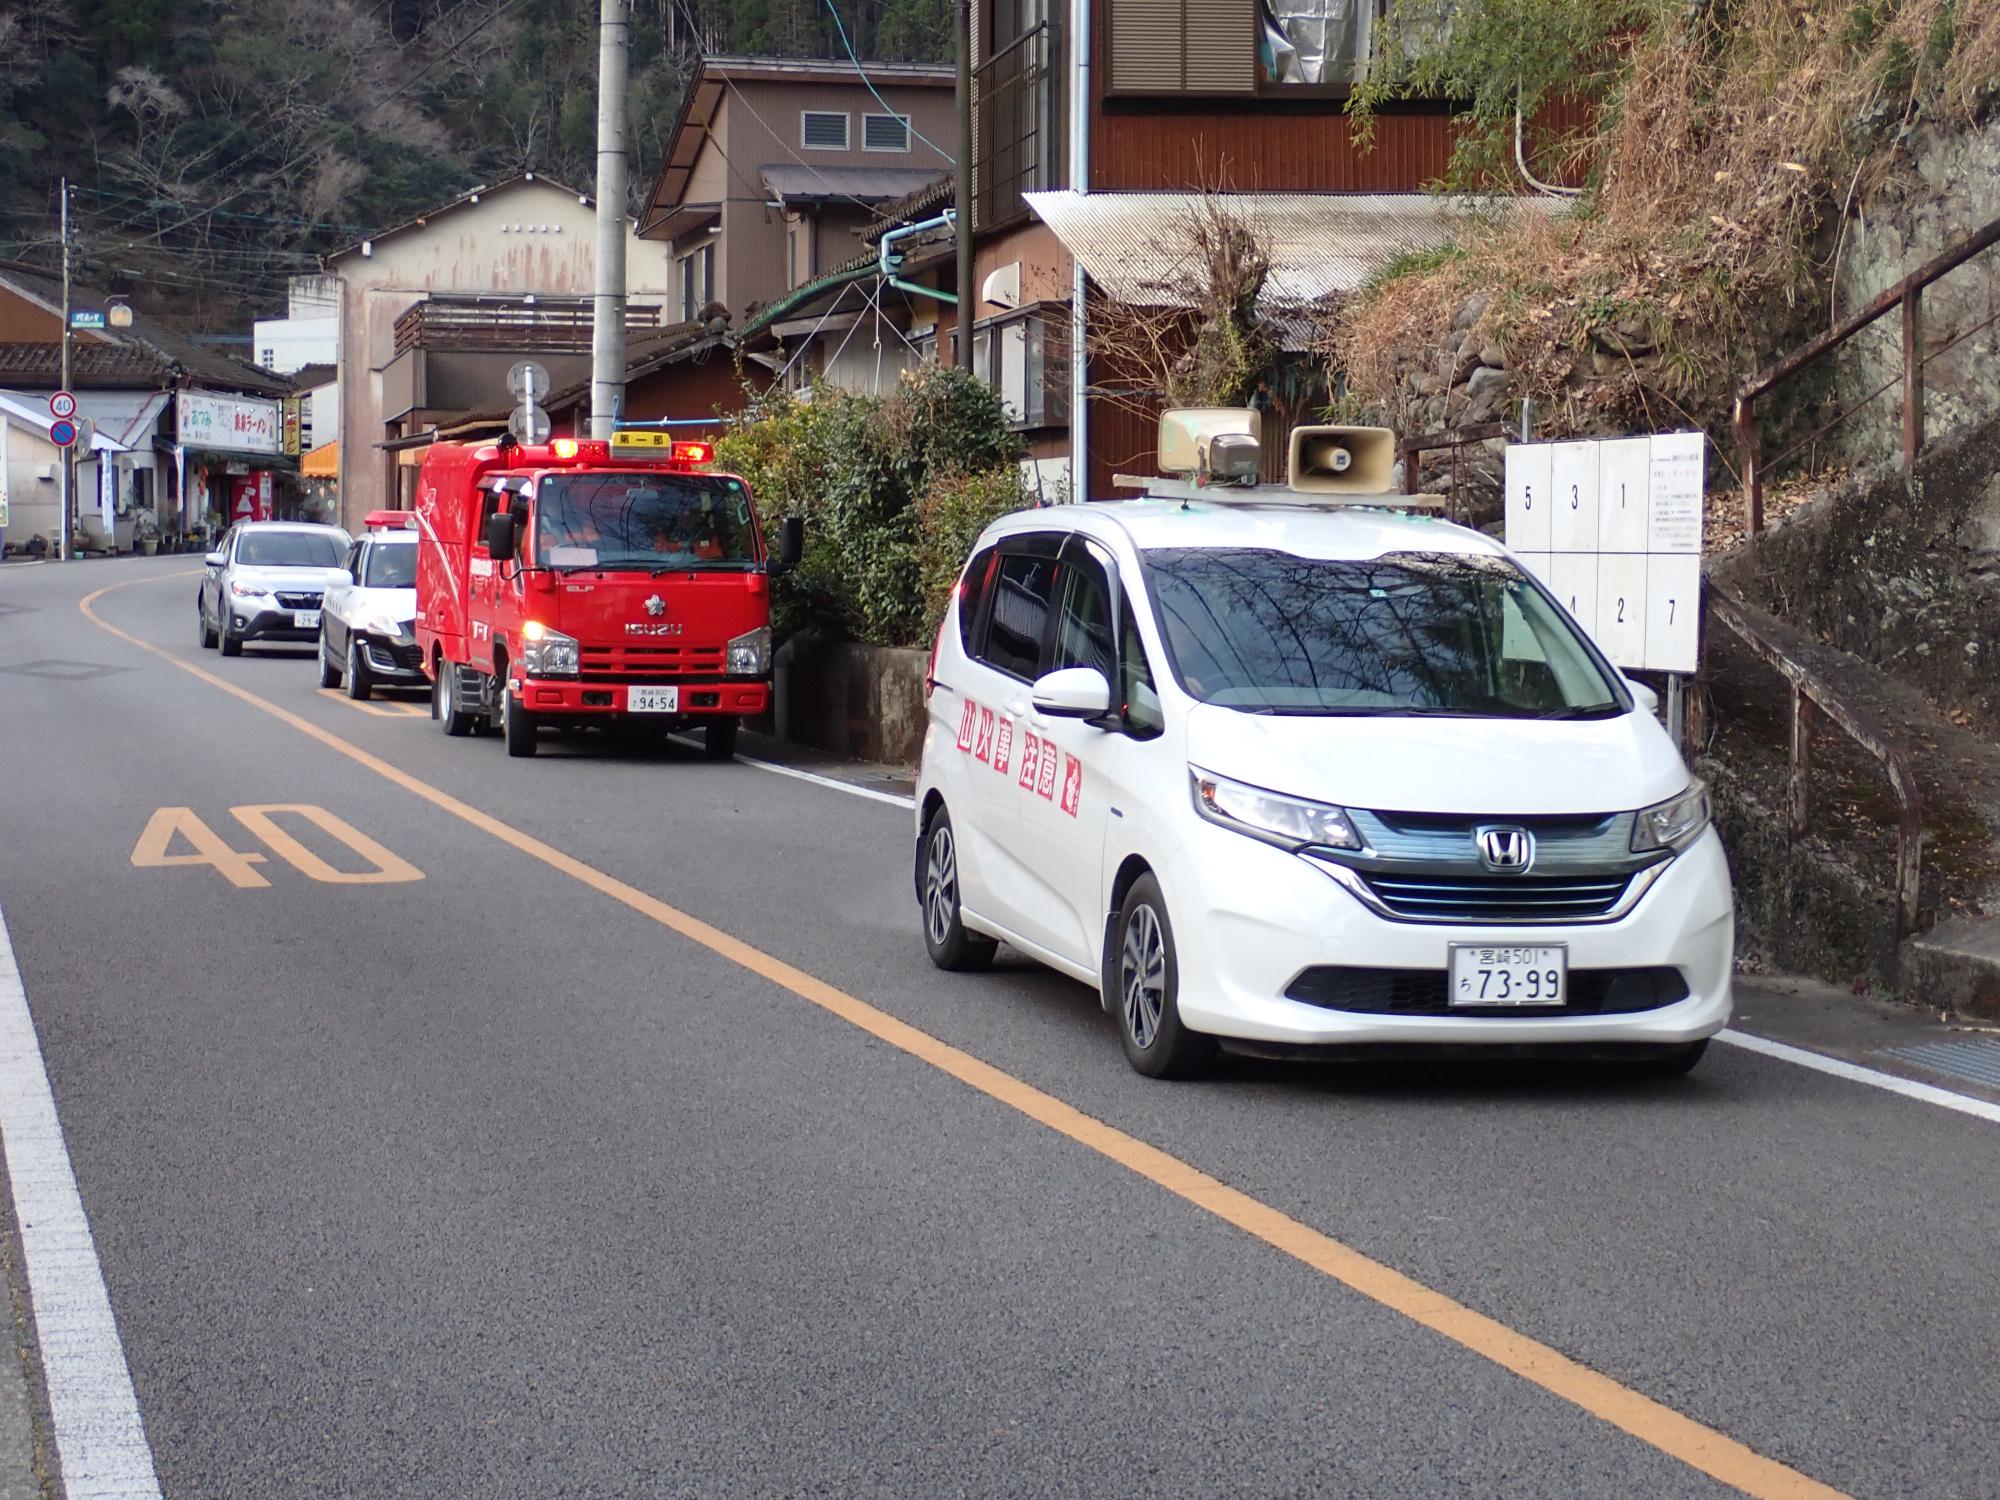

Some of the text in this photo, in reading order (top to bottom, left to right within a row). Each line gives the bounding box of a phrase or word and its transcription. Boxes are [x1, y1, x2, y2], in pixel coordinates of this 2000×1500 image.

[55, 399, 71, 411] 40
[1524, 485, 1532, 510] 5
[1571, 484, 1578, 510] 3
[1621, 483, 1625, 509] 1
[1617, 597, 1624, 623] 2
[1668, 599, 1675, 625] 7
[624, 623, 683, 636] ISUZU
[639, 697, 674, 710] 94-54
[1020, 733, 1058, 797] 注意
[130, 803, 427, 888] 40
[1477, 969, 1559, 999] 73-99
